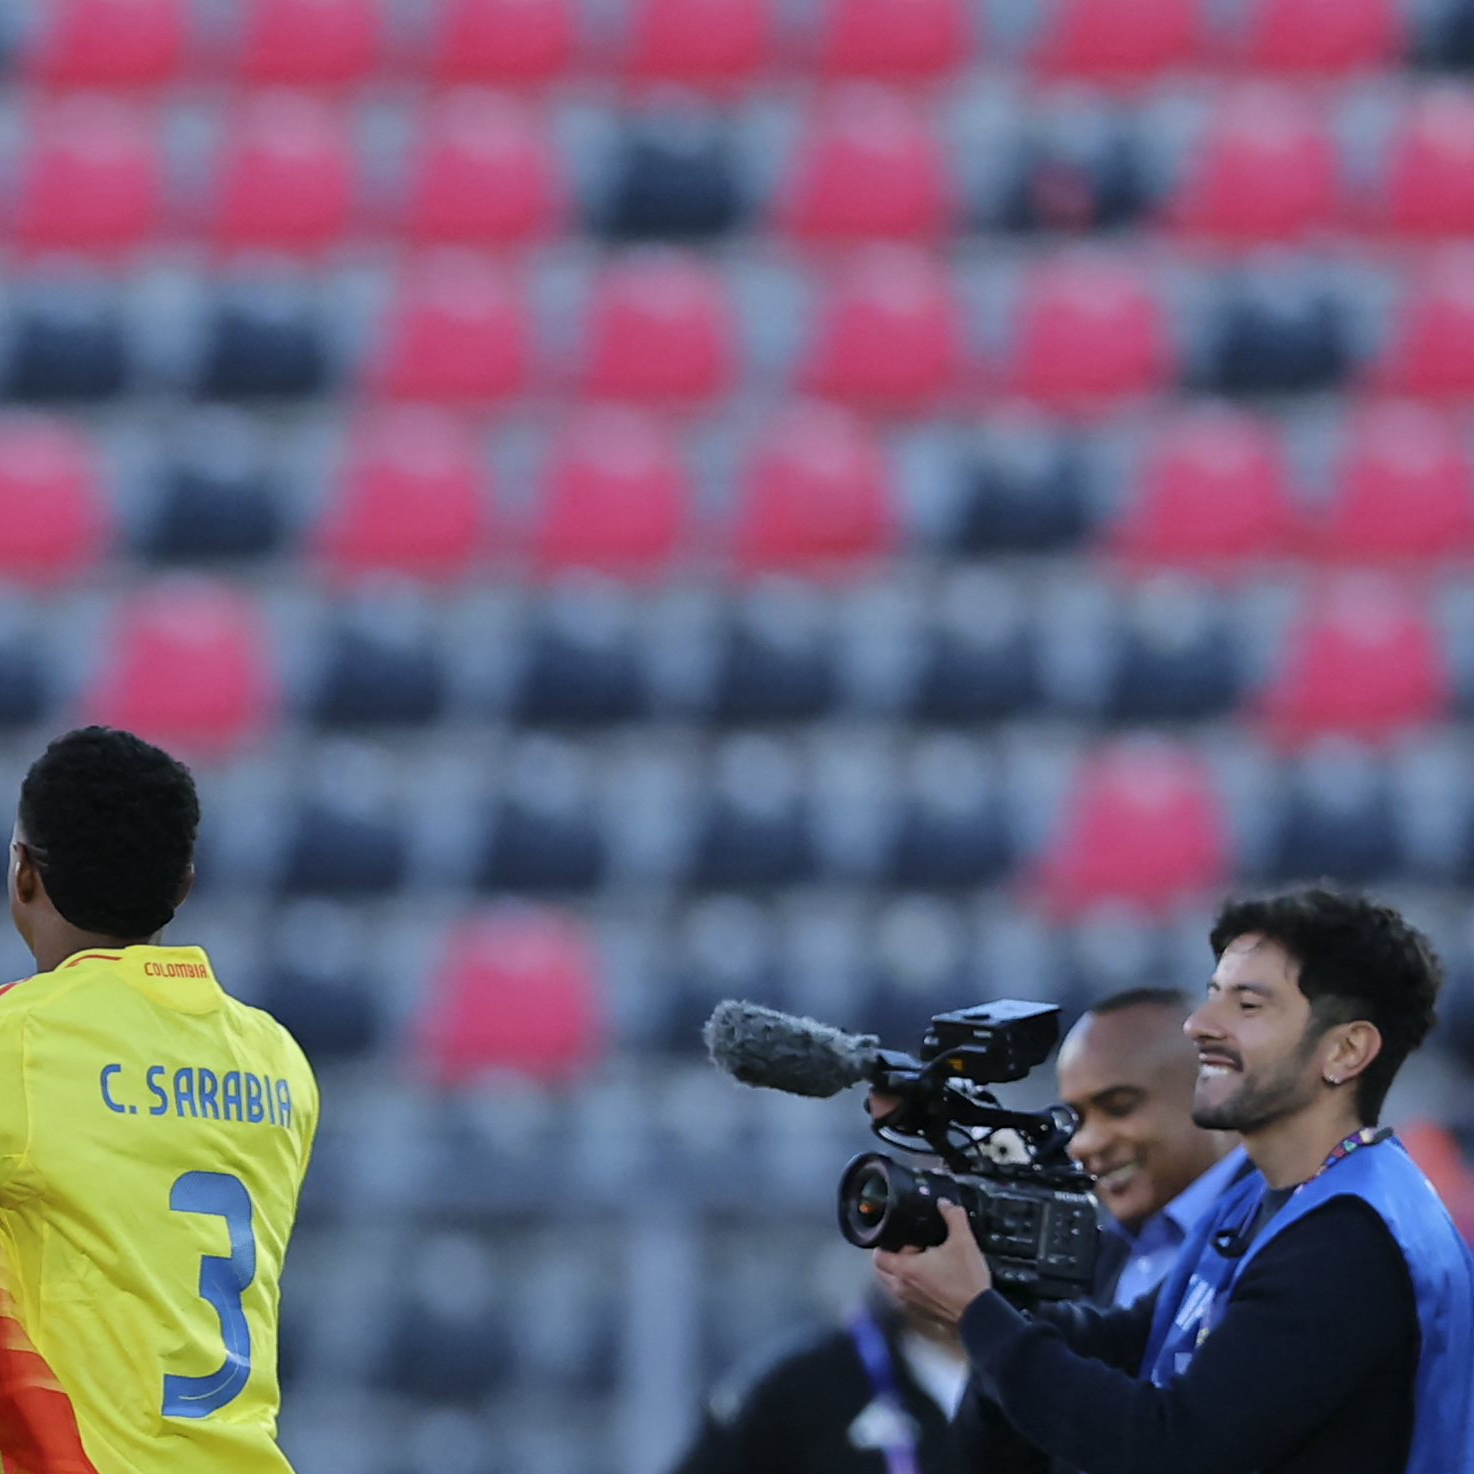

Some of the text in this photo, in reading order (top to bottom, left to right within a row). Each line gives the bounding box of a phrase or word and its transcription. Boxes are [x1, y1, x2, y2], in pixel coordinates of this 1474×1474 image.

[144, 961, 208, 979] COLOMBIA
[100, 1063, 292, 1129] C. SARABIA
[161, 1170, 257, 1419] 3
